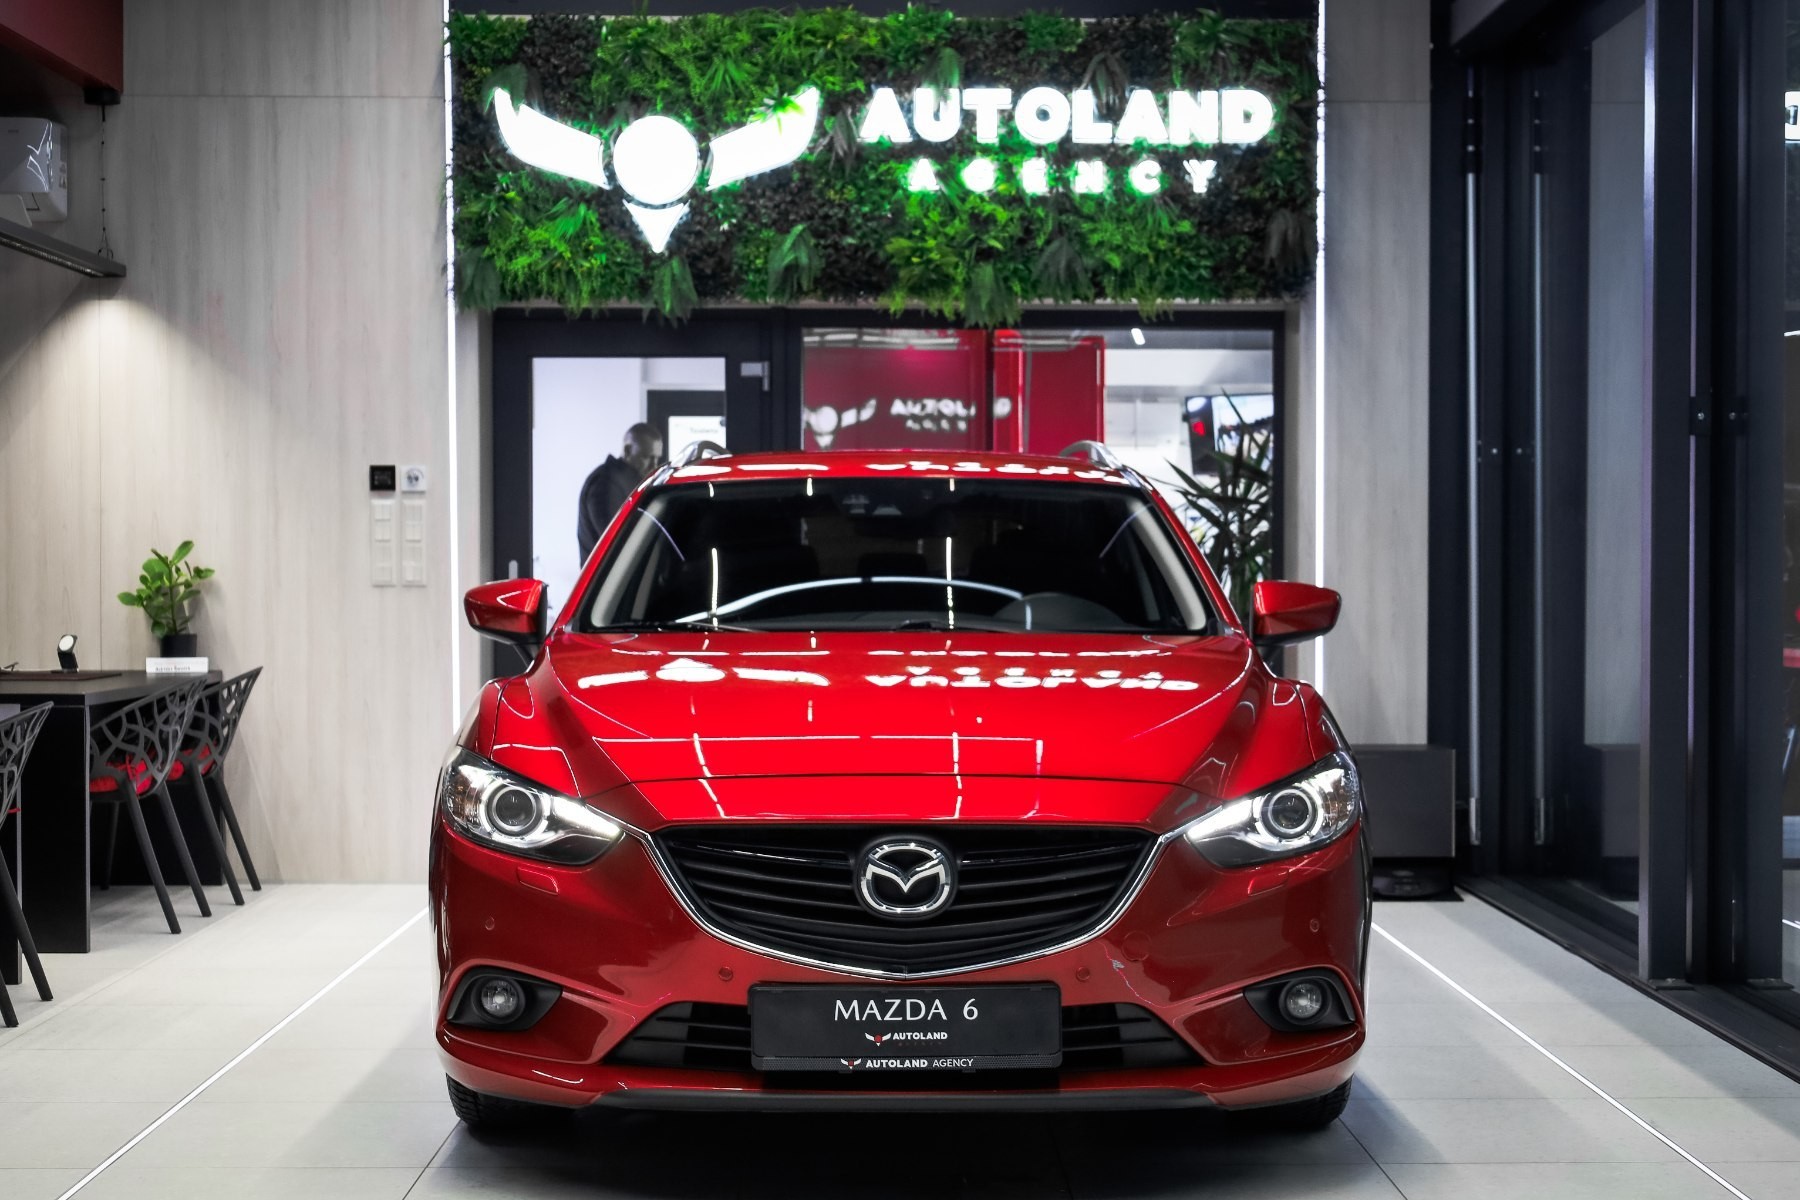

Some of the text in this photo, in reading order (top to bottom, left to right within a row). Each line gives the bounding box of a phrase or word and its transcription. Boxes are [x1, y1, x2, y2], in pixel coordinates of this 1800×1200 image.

[858, 87, 1274, 144] AUTOLAND
[908, 156, 1218, 195] AGENCY
[834, 998, 979, 1021] MAZDA 6
[892, 1031, 948, 1041] AUTOLAND
[865, 1058, 974, 1069] AUTOLAND AGENCY
